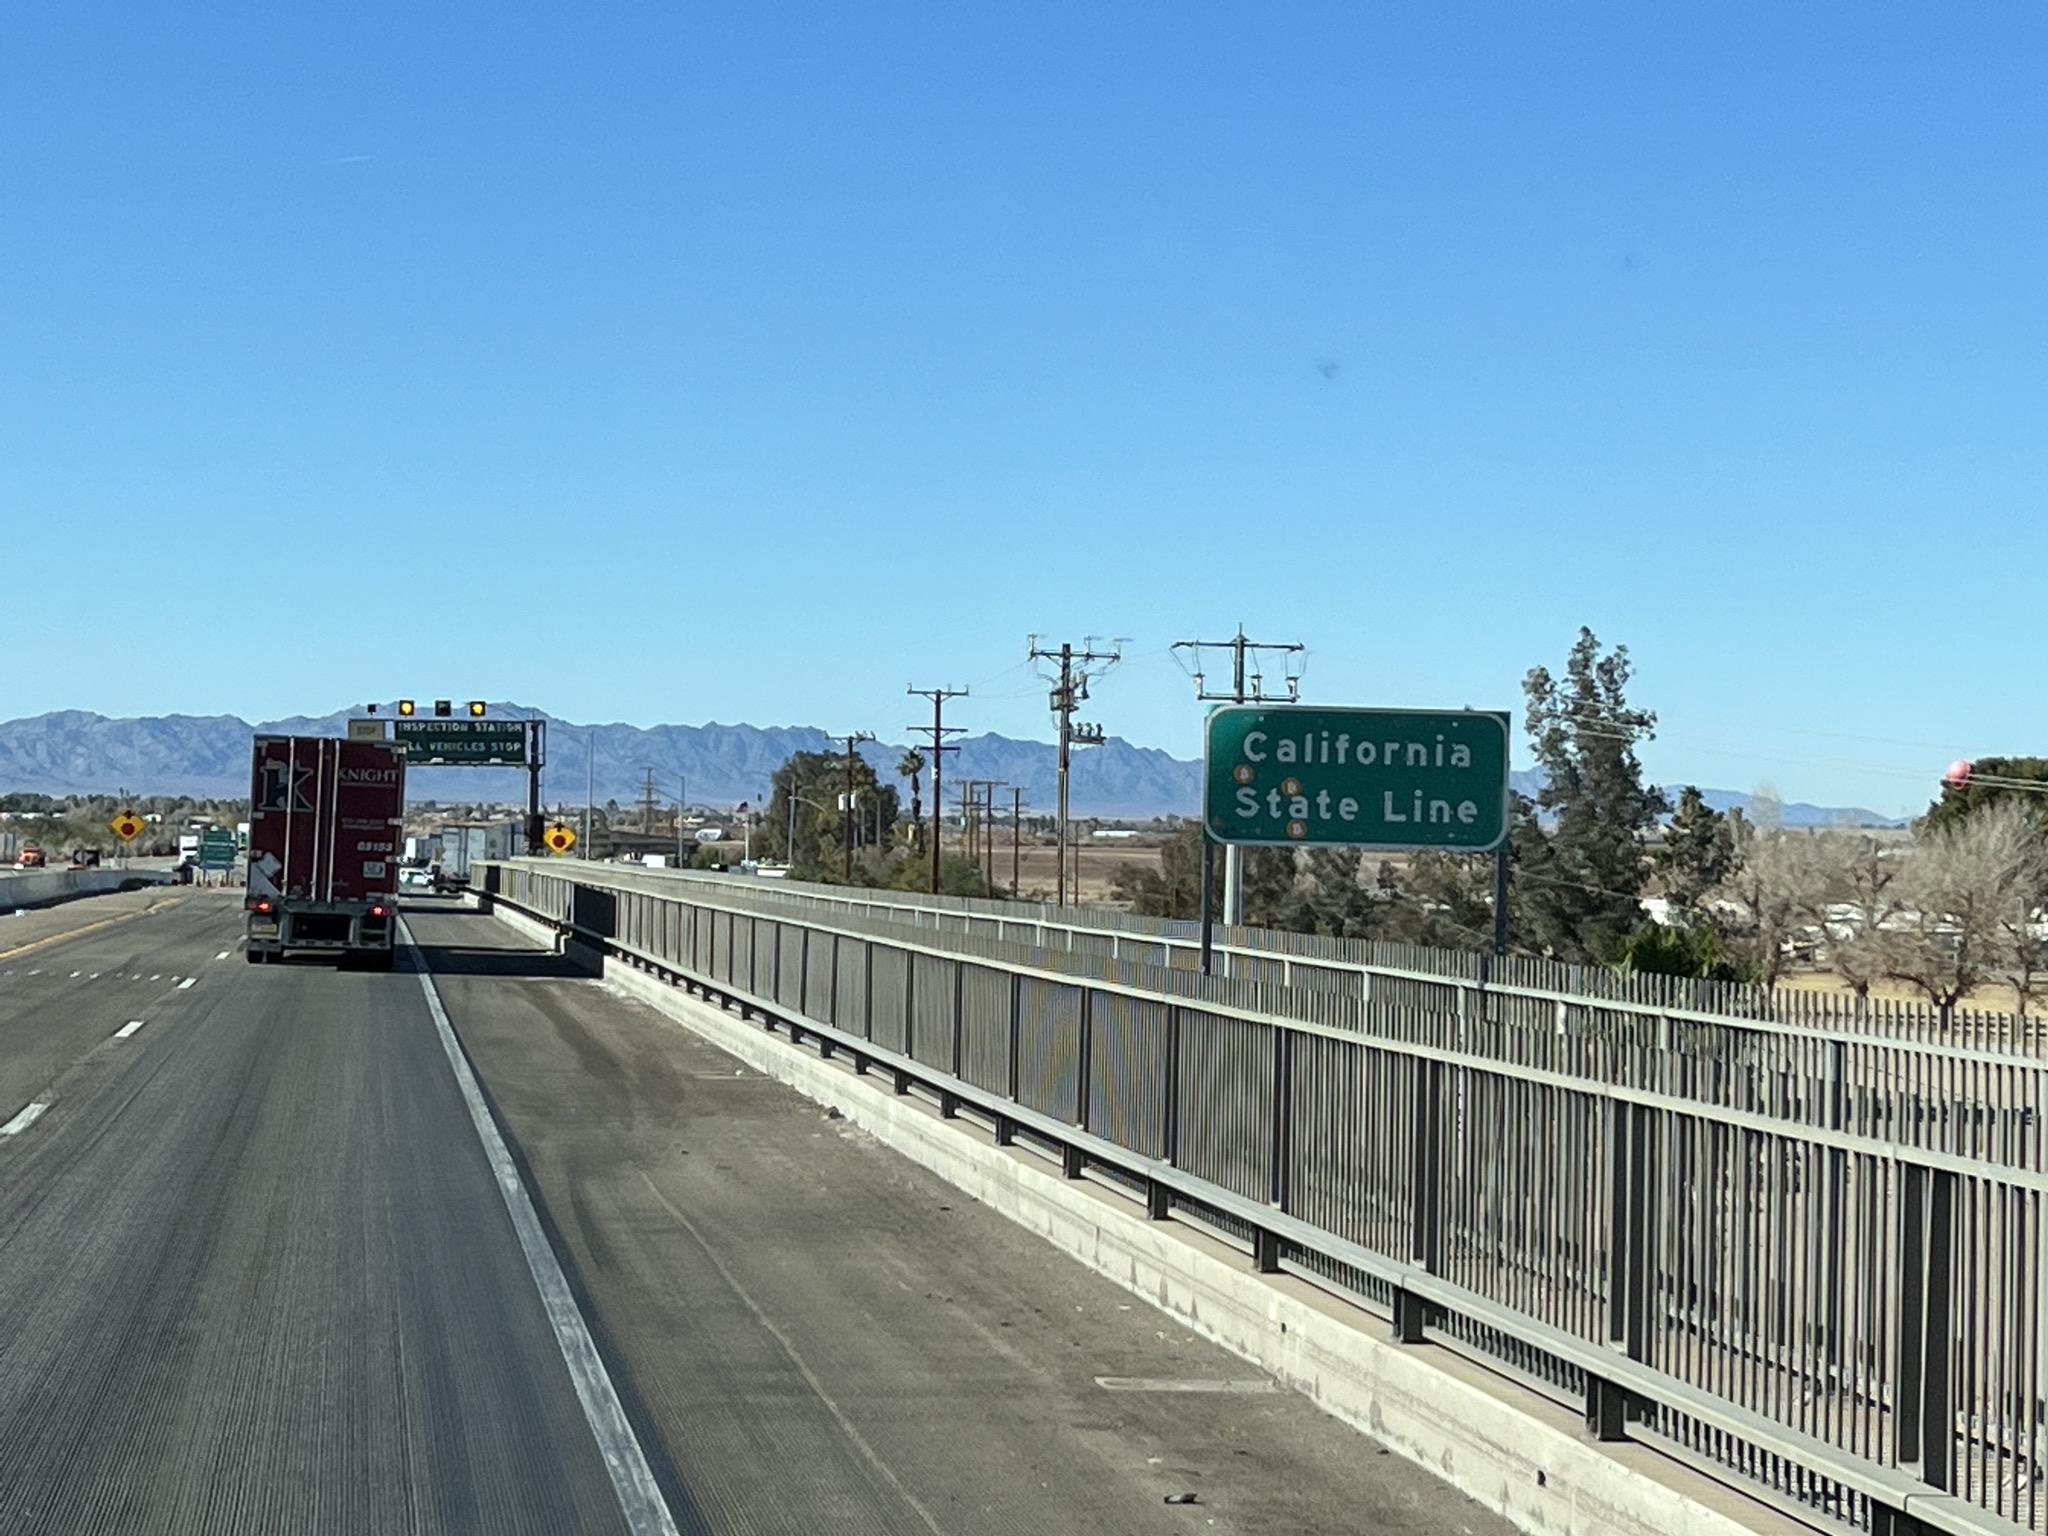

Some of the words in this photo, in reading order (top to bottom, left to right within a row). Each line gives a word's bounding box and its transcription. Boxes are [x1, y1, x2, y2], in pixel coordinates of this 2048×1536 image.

[397, 722, 469, 732] INSPECTION
[474, 722, 523, 732] STATION
[407, 741, 424, 751] LL
[429, 741, 486, 751] VEHICLES
[491, 742, 522, 751] STOP
[1243, 730, 1472, 768] California
[338, 768, 399, 783] KNIGHT
[1234, 786, 1360, 821] State
[1383, 789, 1479, 824] Line
